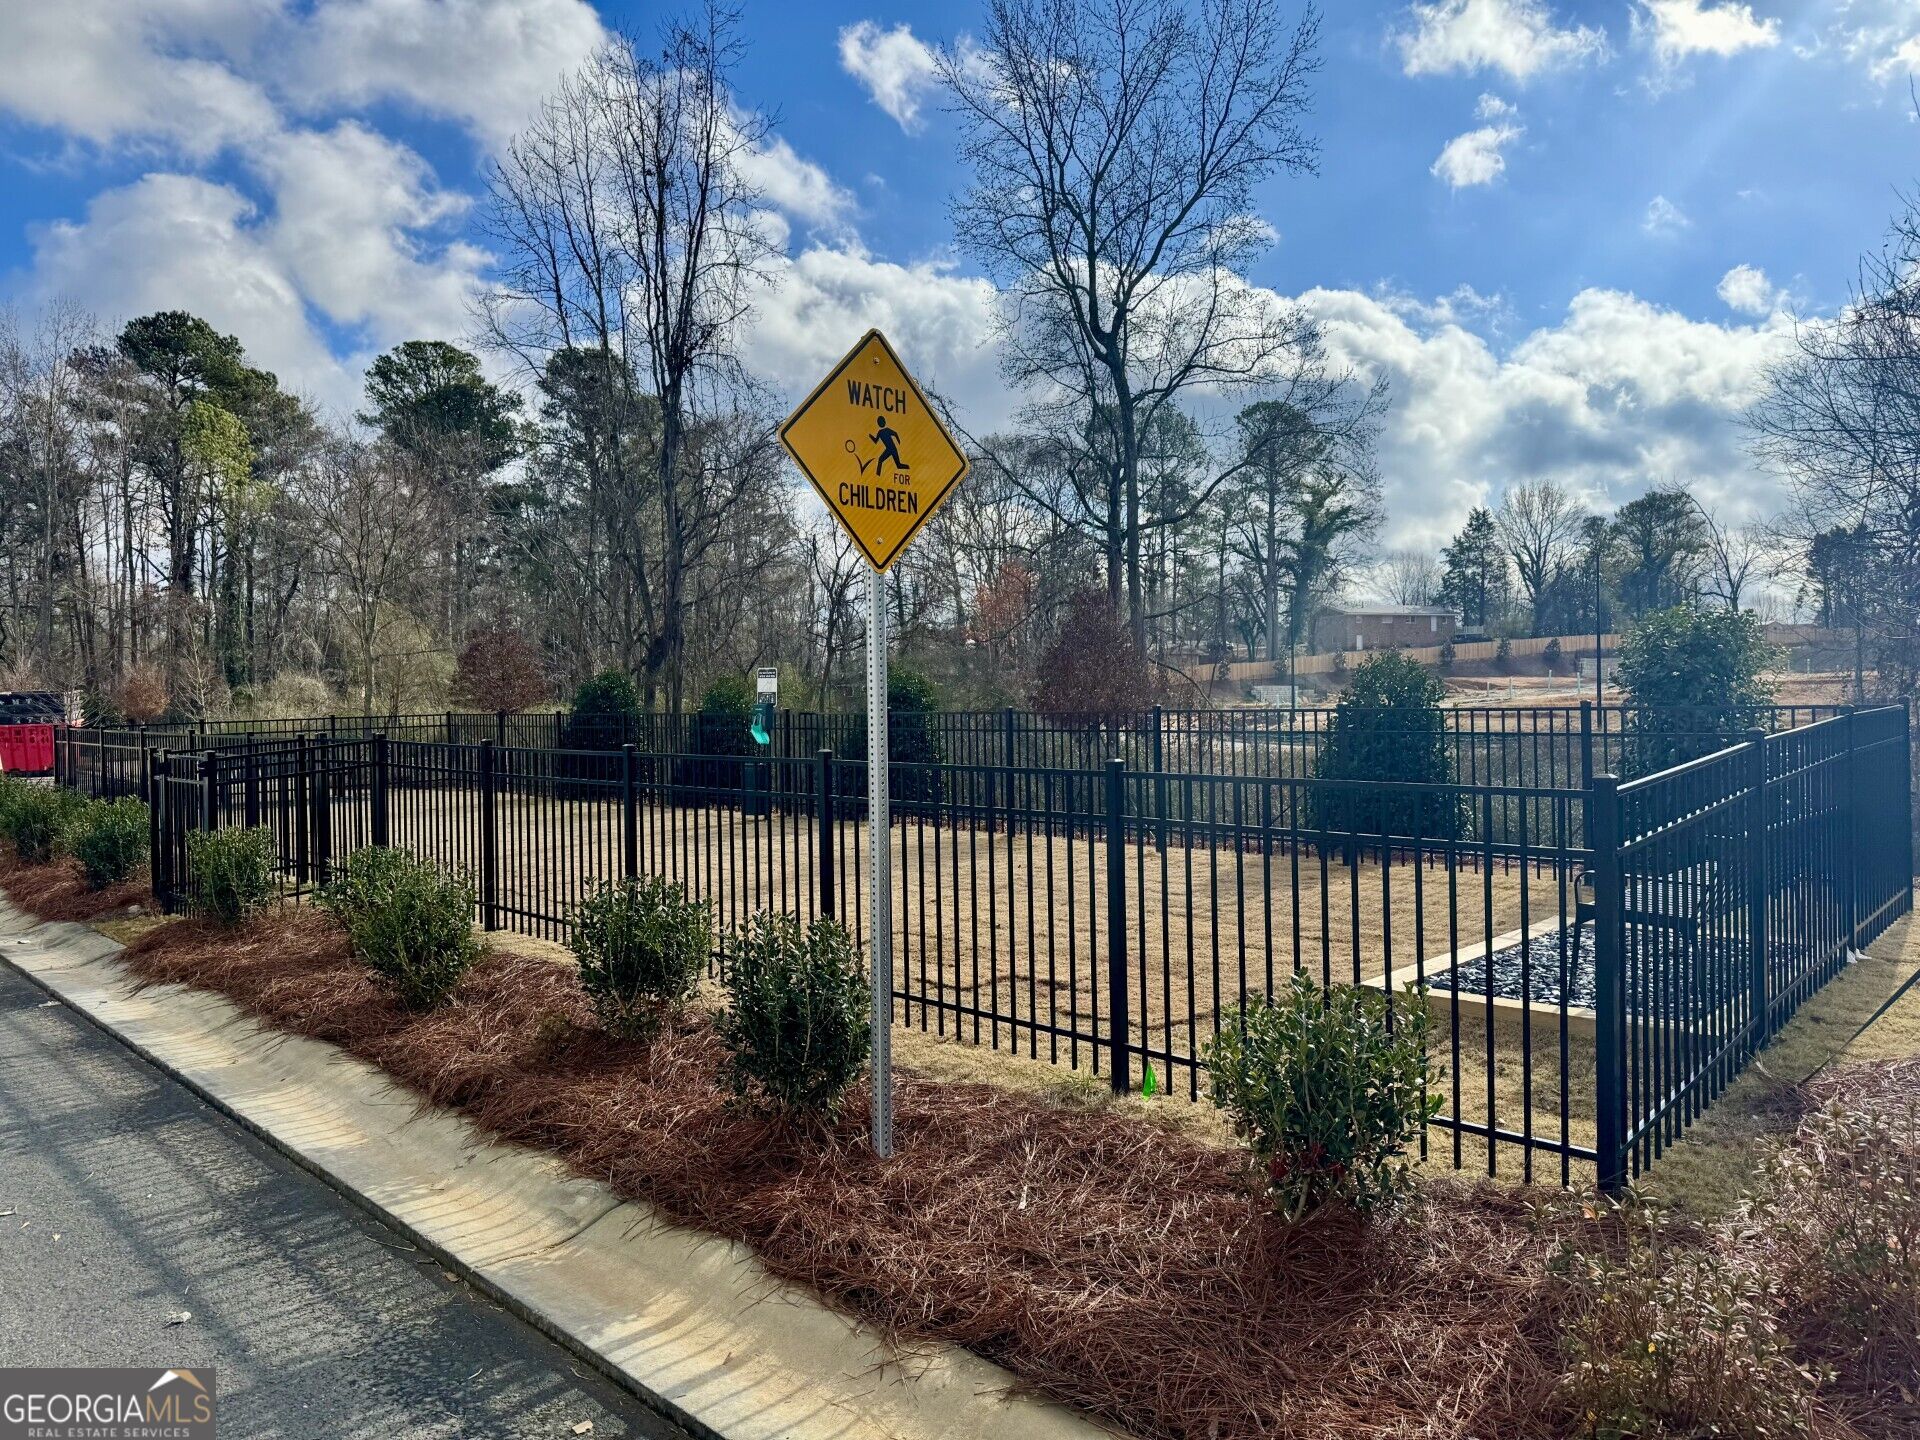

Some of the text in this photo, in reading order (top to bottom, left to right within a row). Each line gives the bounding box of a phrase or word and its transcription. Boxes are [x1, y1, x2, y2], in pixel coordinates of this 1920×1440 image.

[847, 379, 907, 415] WATCH
[893, 473, 911, 486] FOR
[838, 482, 918, 515] CHILDREN
